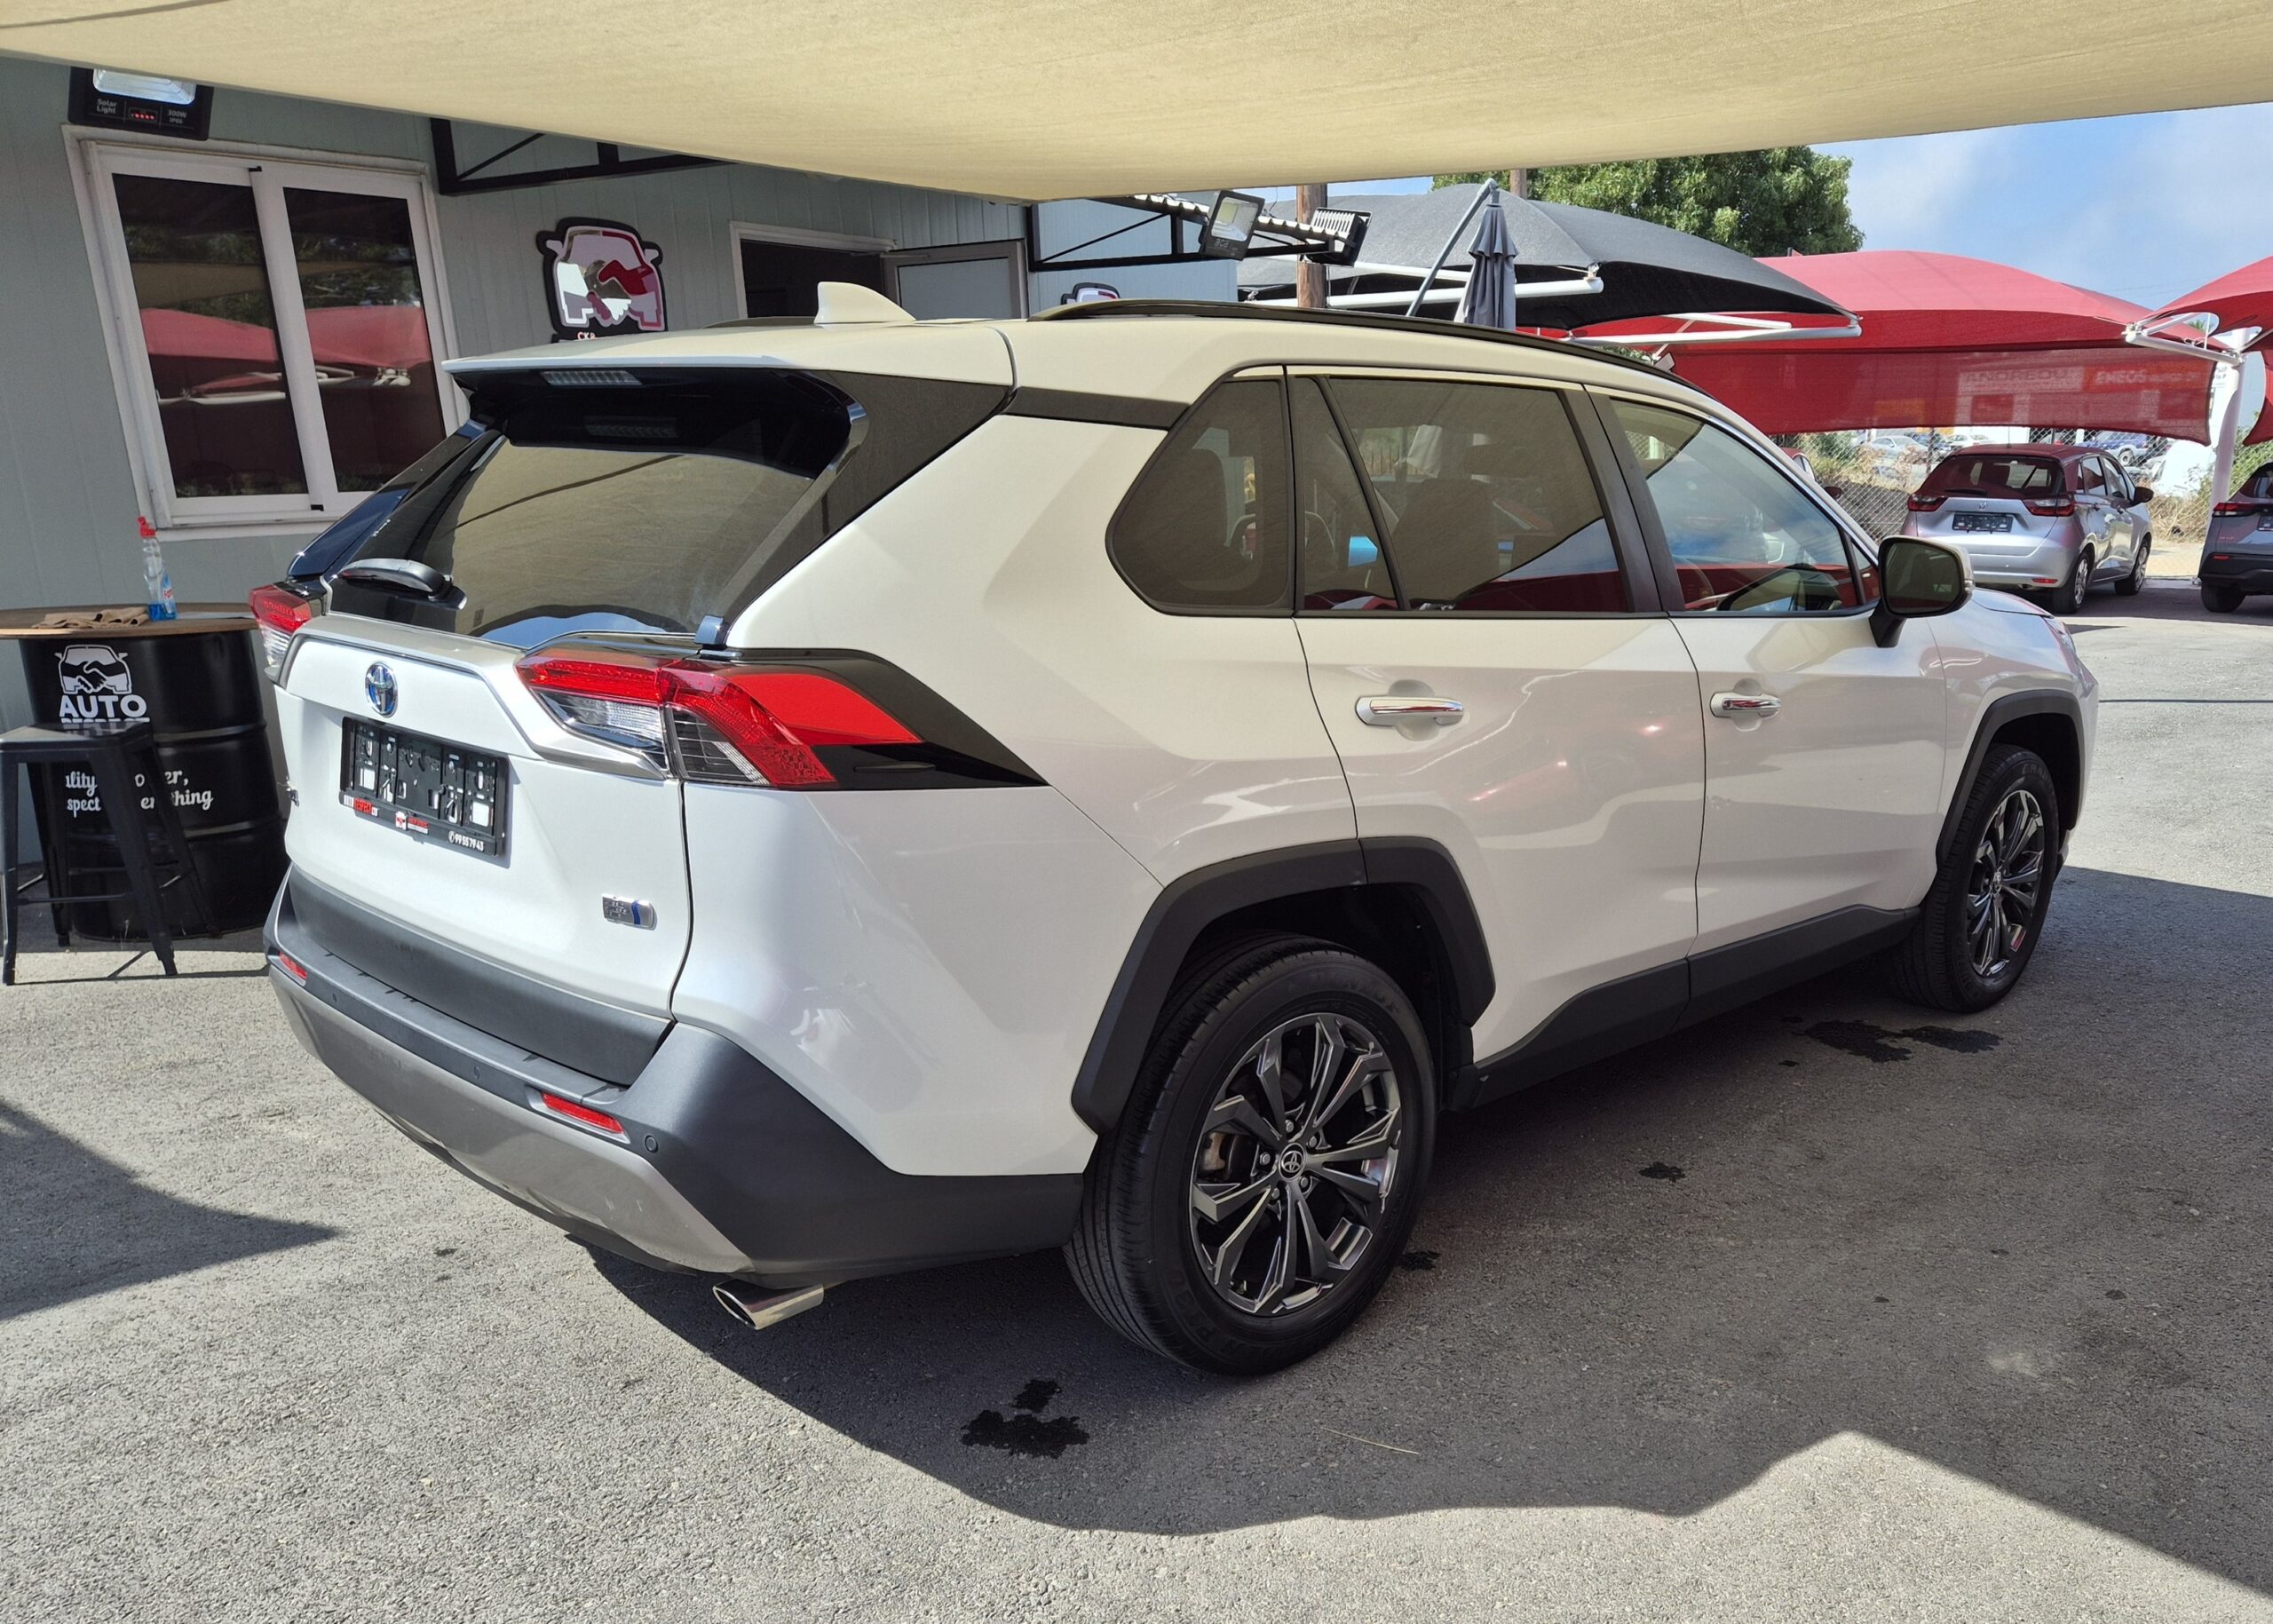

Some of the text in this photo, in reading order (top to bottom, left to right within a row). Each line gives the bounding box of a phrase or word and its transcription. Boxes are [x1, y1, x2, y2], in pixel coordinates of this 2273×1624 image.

[97, 99, 117, 107] Solar
[96, 105, 116, 115] Light
[167, 109, 187, 119] 300W
[59, 694, 147, 718] AUTO
